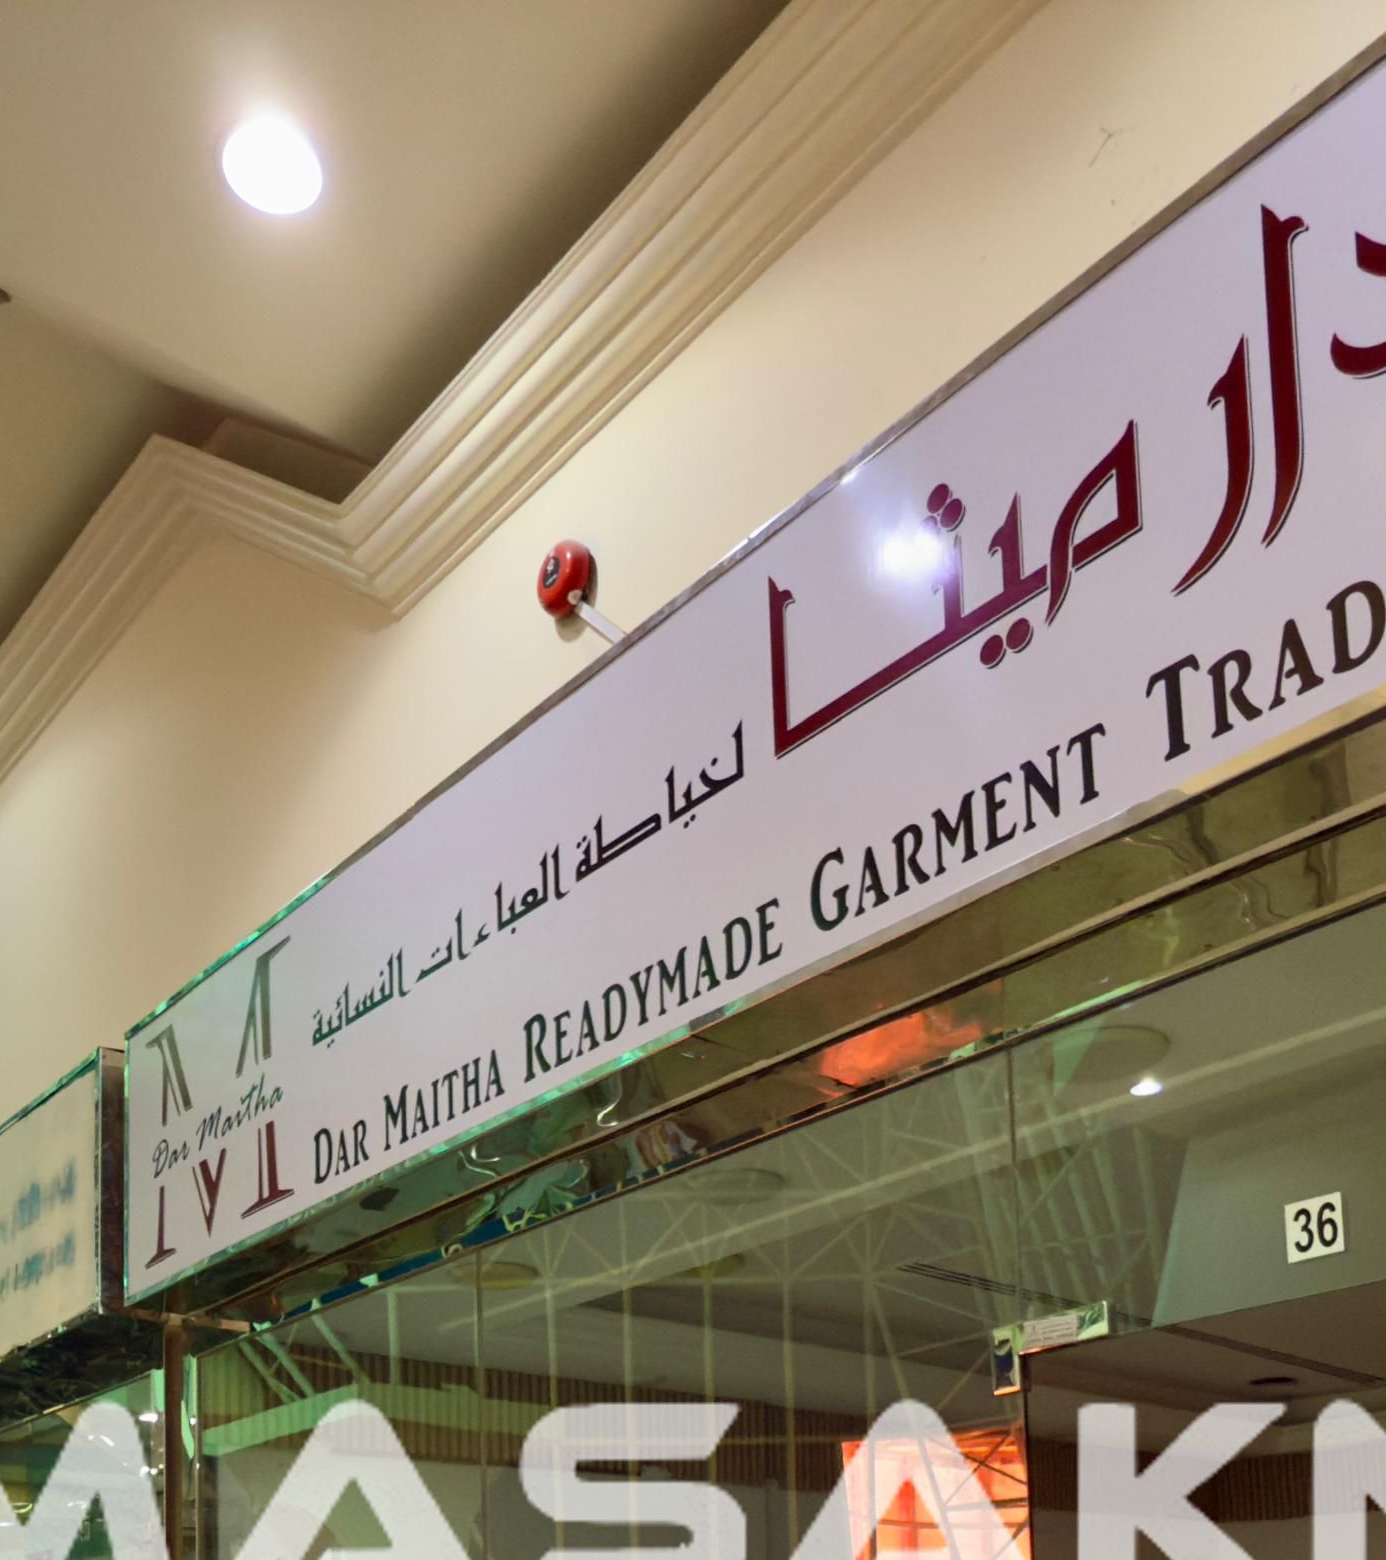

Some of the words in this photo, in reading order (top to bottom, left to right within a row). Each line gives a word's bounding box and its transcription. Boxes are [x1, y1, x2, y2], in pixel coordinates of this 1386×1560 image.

[574, 718, 745, 884] لخياطة
[311, 946, 411, 1049] النسائية
[313, 1118, 371, 1185] DAR
[382, 1048, 506, 1153] MAITHA
[522, 896, 784, 1084] READYMADE
[808, 722, 1108, 933] GARMENT
[150, 1138, 191, 1179] Dar
[194, 1072, 284, 1153] Maitha
[1293, 1201, 1339, 1253] 36
